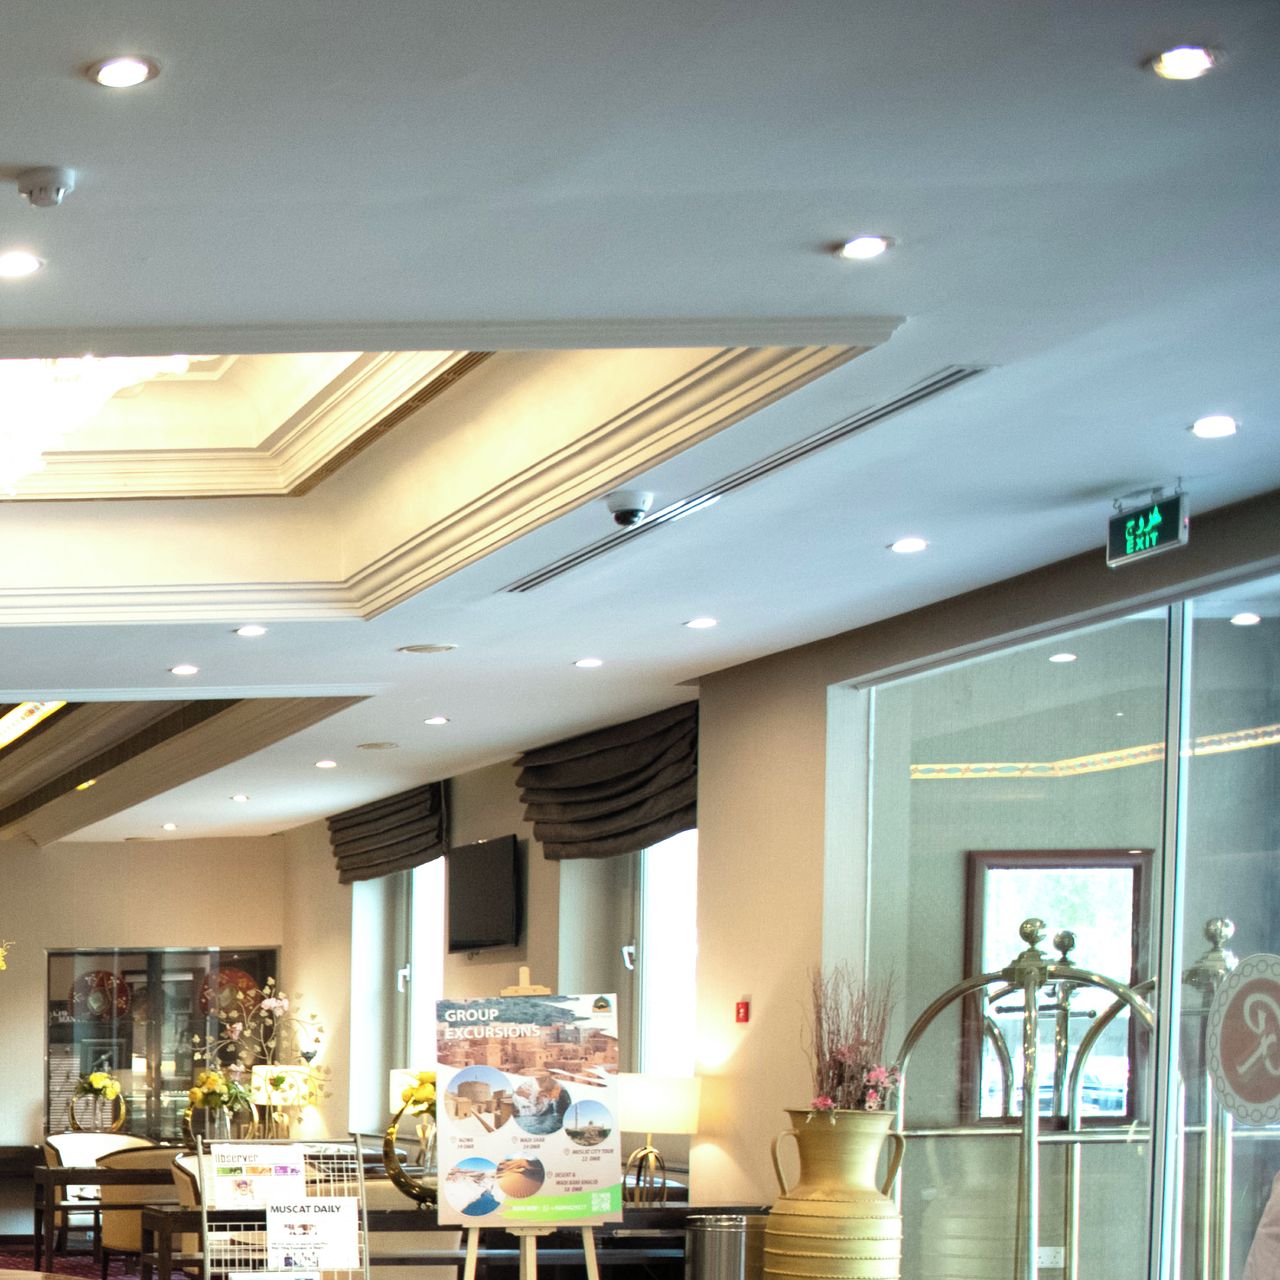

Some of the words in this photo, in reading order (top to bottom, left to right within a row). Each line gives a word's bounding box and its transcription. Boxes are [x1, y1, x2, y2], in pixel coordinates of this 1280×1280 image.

[1126, 531, 1159, 554] EXIT
[445, 1009, 499, 1022] GROUP
[444, 1026, 541, 1040] EXCURSIONS
[270, 1205, 311, 1214] MUSCAT
[313, 1205, 341, 1213] DAILY
